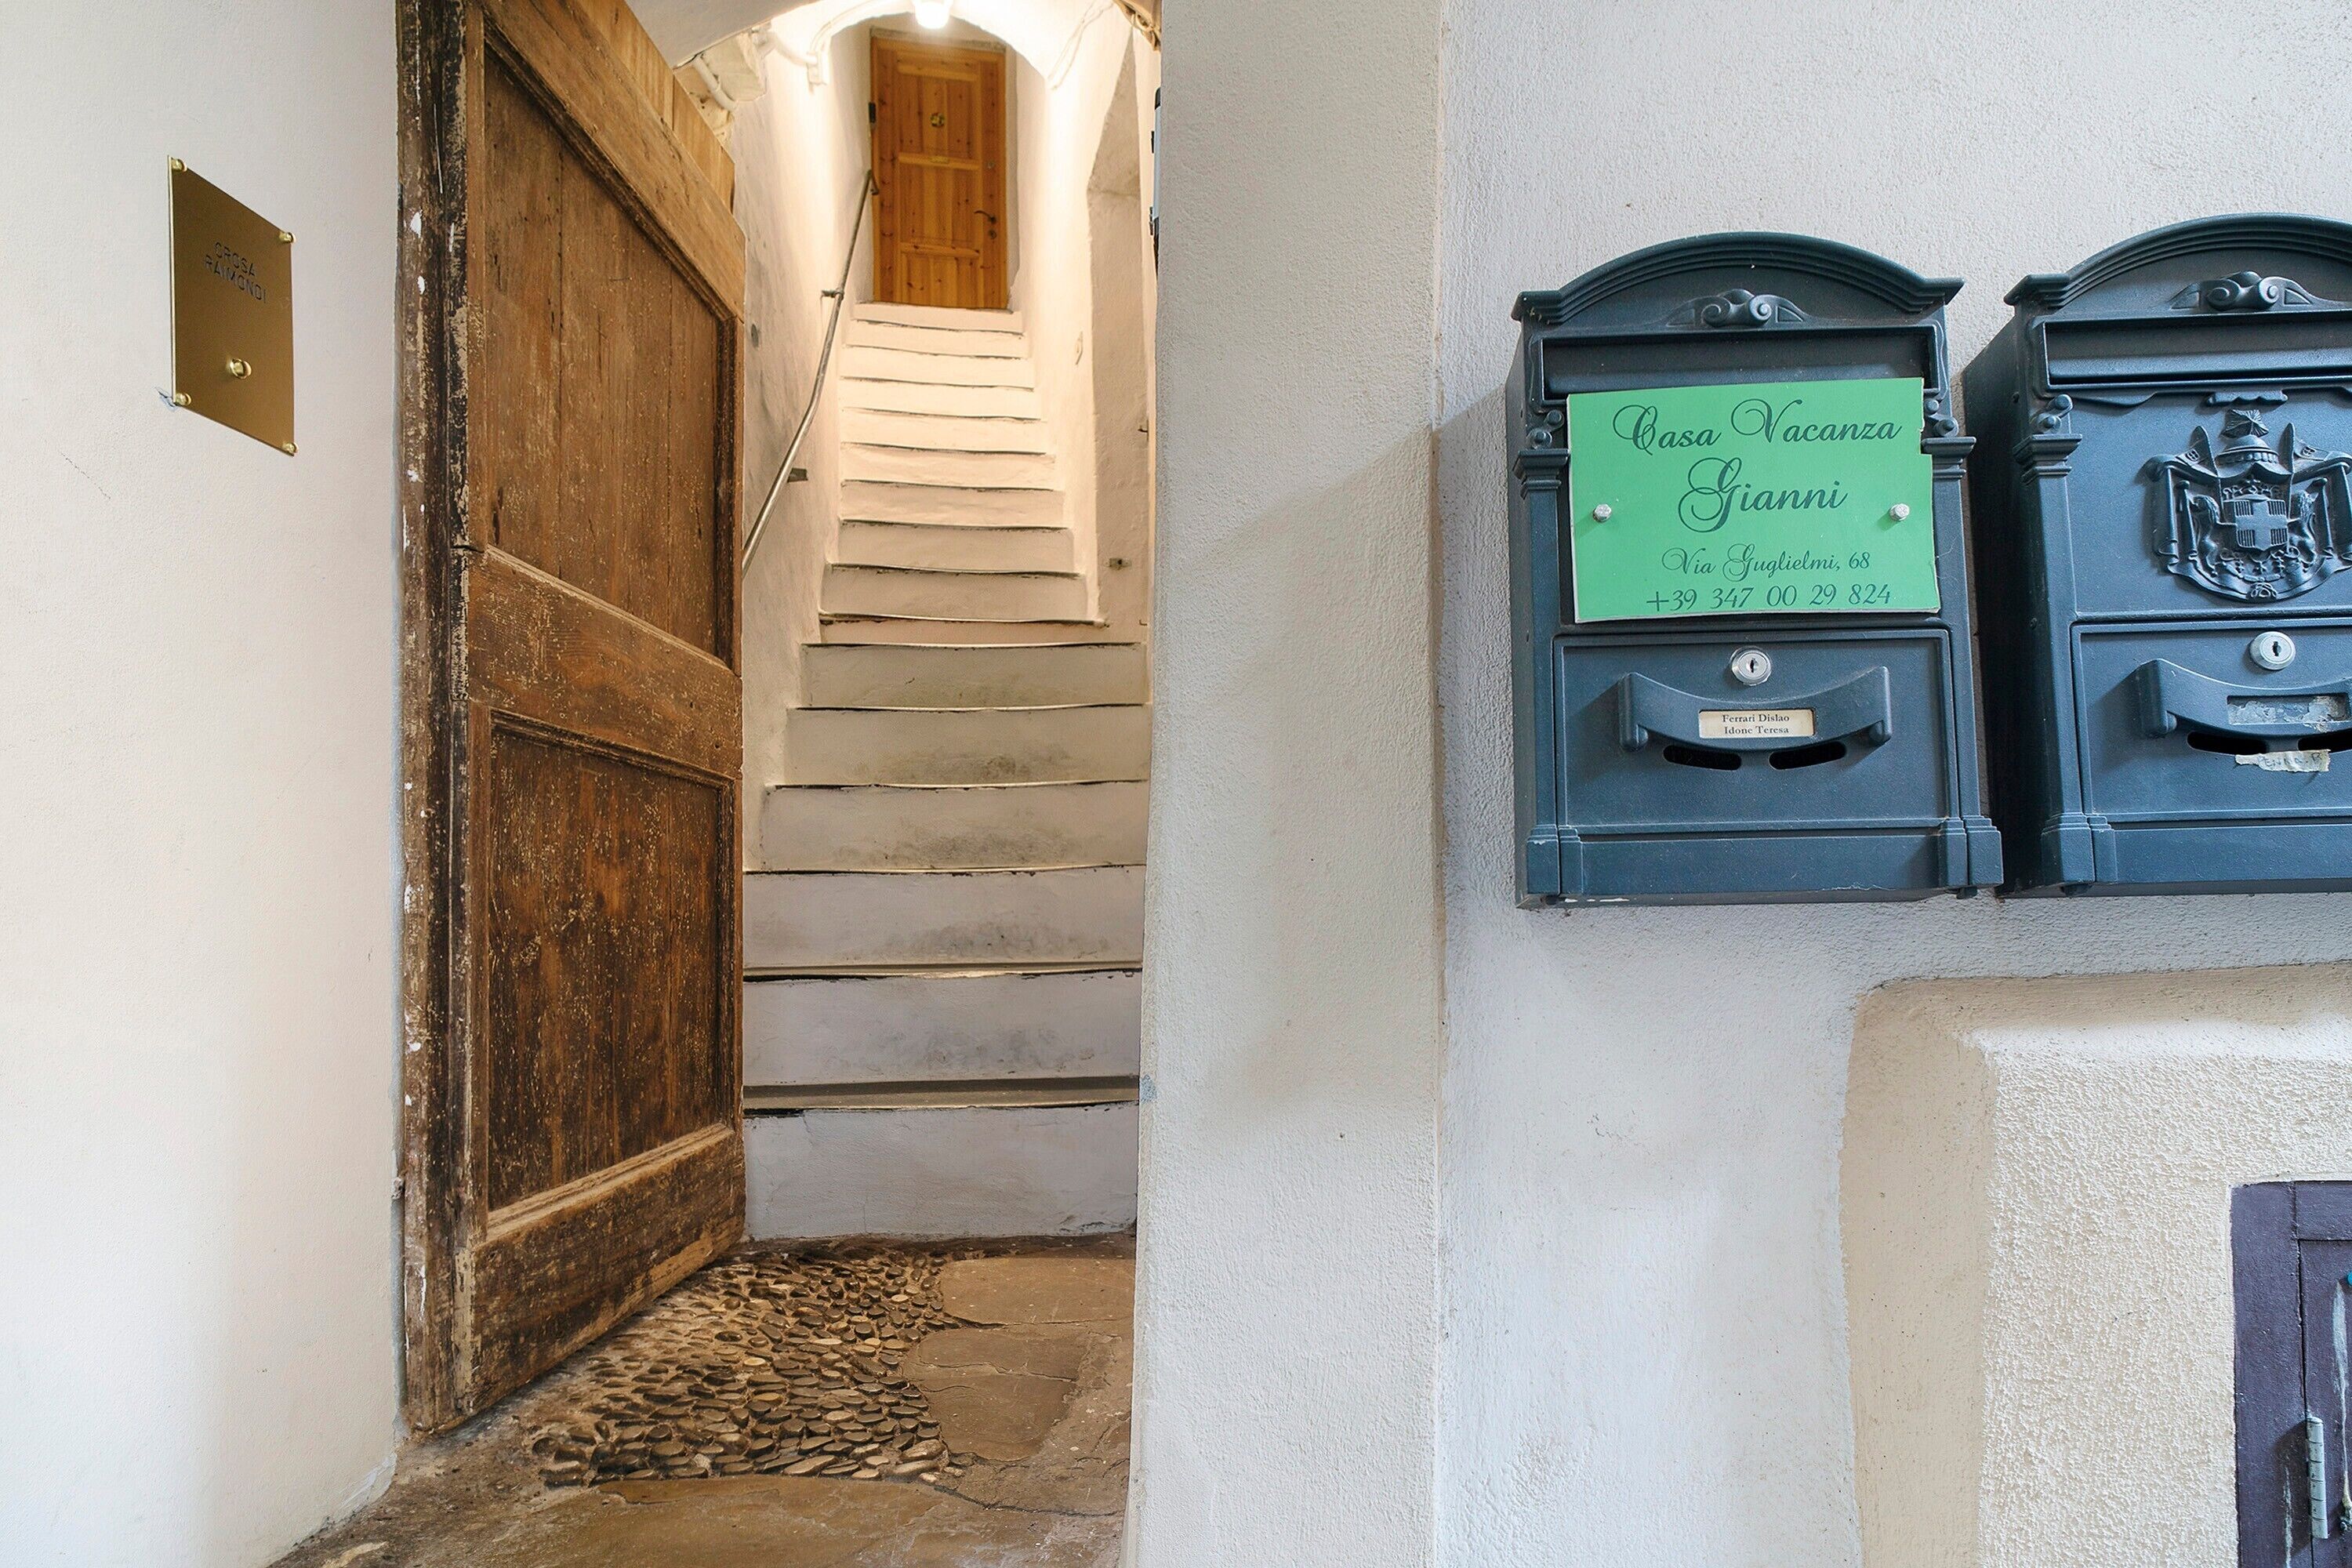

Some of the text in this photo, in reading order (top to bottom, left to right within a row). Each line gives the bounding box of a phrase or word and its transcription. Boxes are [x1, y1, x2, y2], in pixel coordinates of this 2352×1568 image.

[215, 241, 256, 277] CROSA
[205, 254, 267, 303] RAIMONDI
[1612, 398, 1903, 456] Casa Vacanza
[1677, 456, 1849, 533] Gianni
[1661, 543, 1871, 583] Via Guglielmi, 68
[1646, 583, 1891, 612] +39 347 00 29 824
[1722, 713, 1790, 723] Ferrari Dislao
[1724, 725, 1789, 735] Idone Teresa
